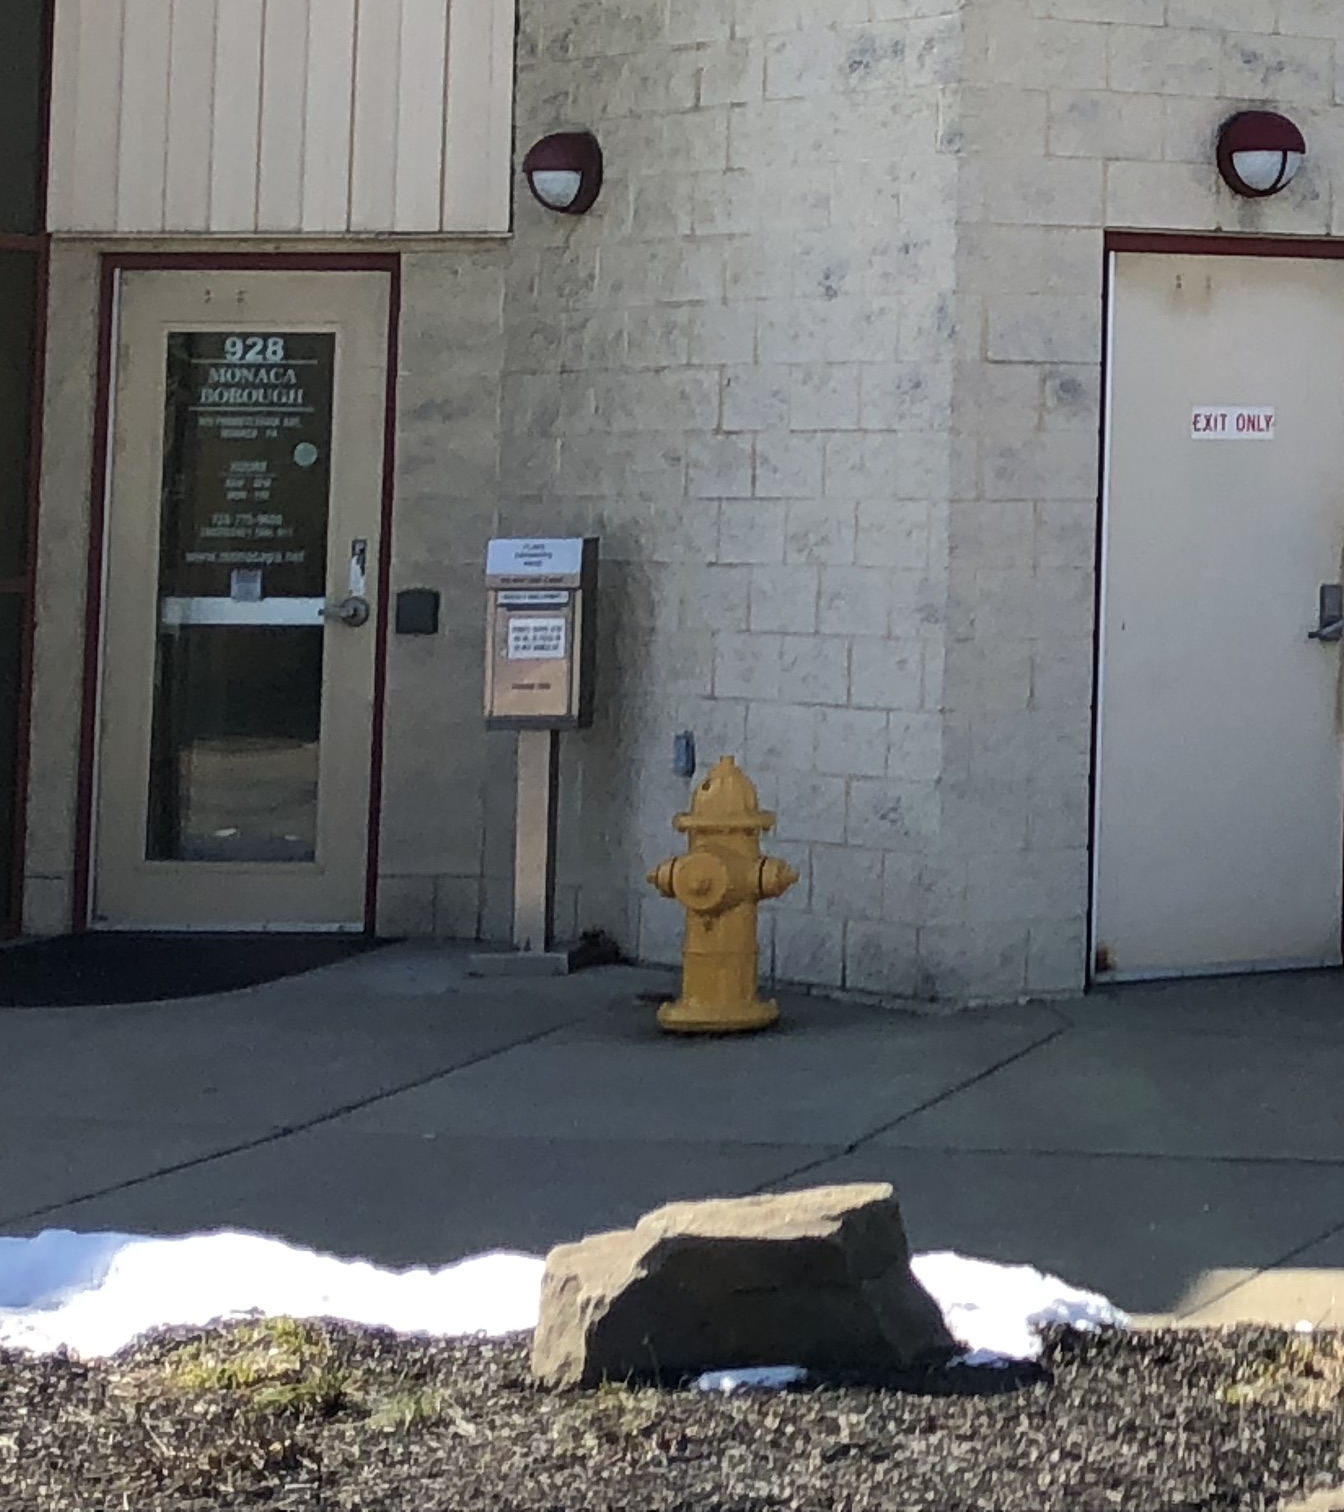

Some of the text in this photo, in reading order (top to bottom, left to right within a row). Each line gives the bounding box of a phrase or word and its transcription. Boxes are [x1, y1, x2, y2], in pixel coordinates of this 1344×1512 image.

[224, 336, 285, 362] 928
[207, 367, 297, 384] MONACA
[200, 388, 304, 405] BOROUGH
[1193, 413, 1274, 432] EXIT ONLY
